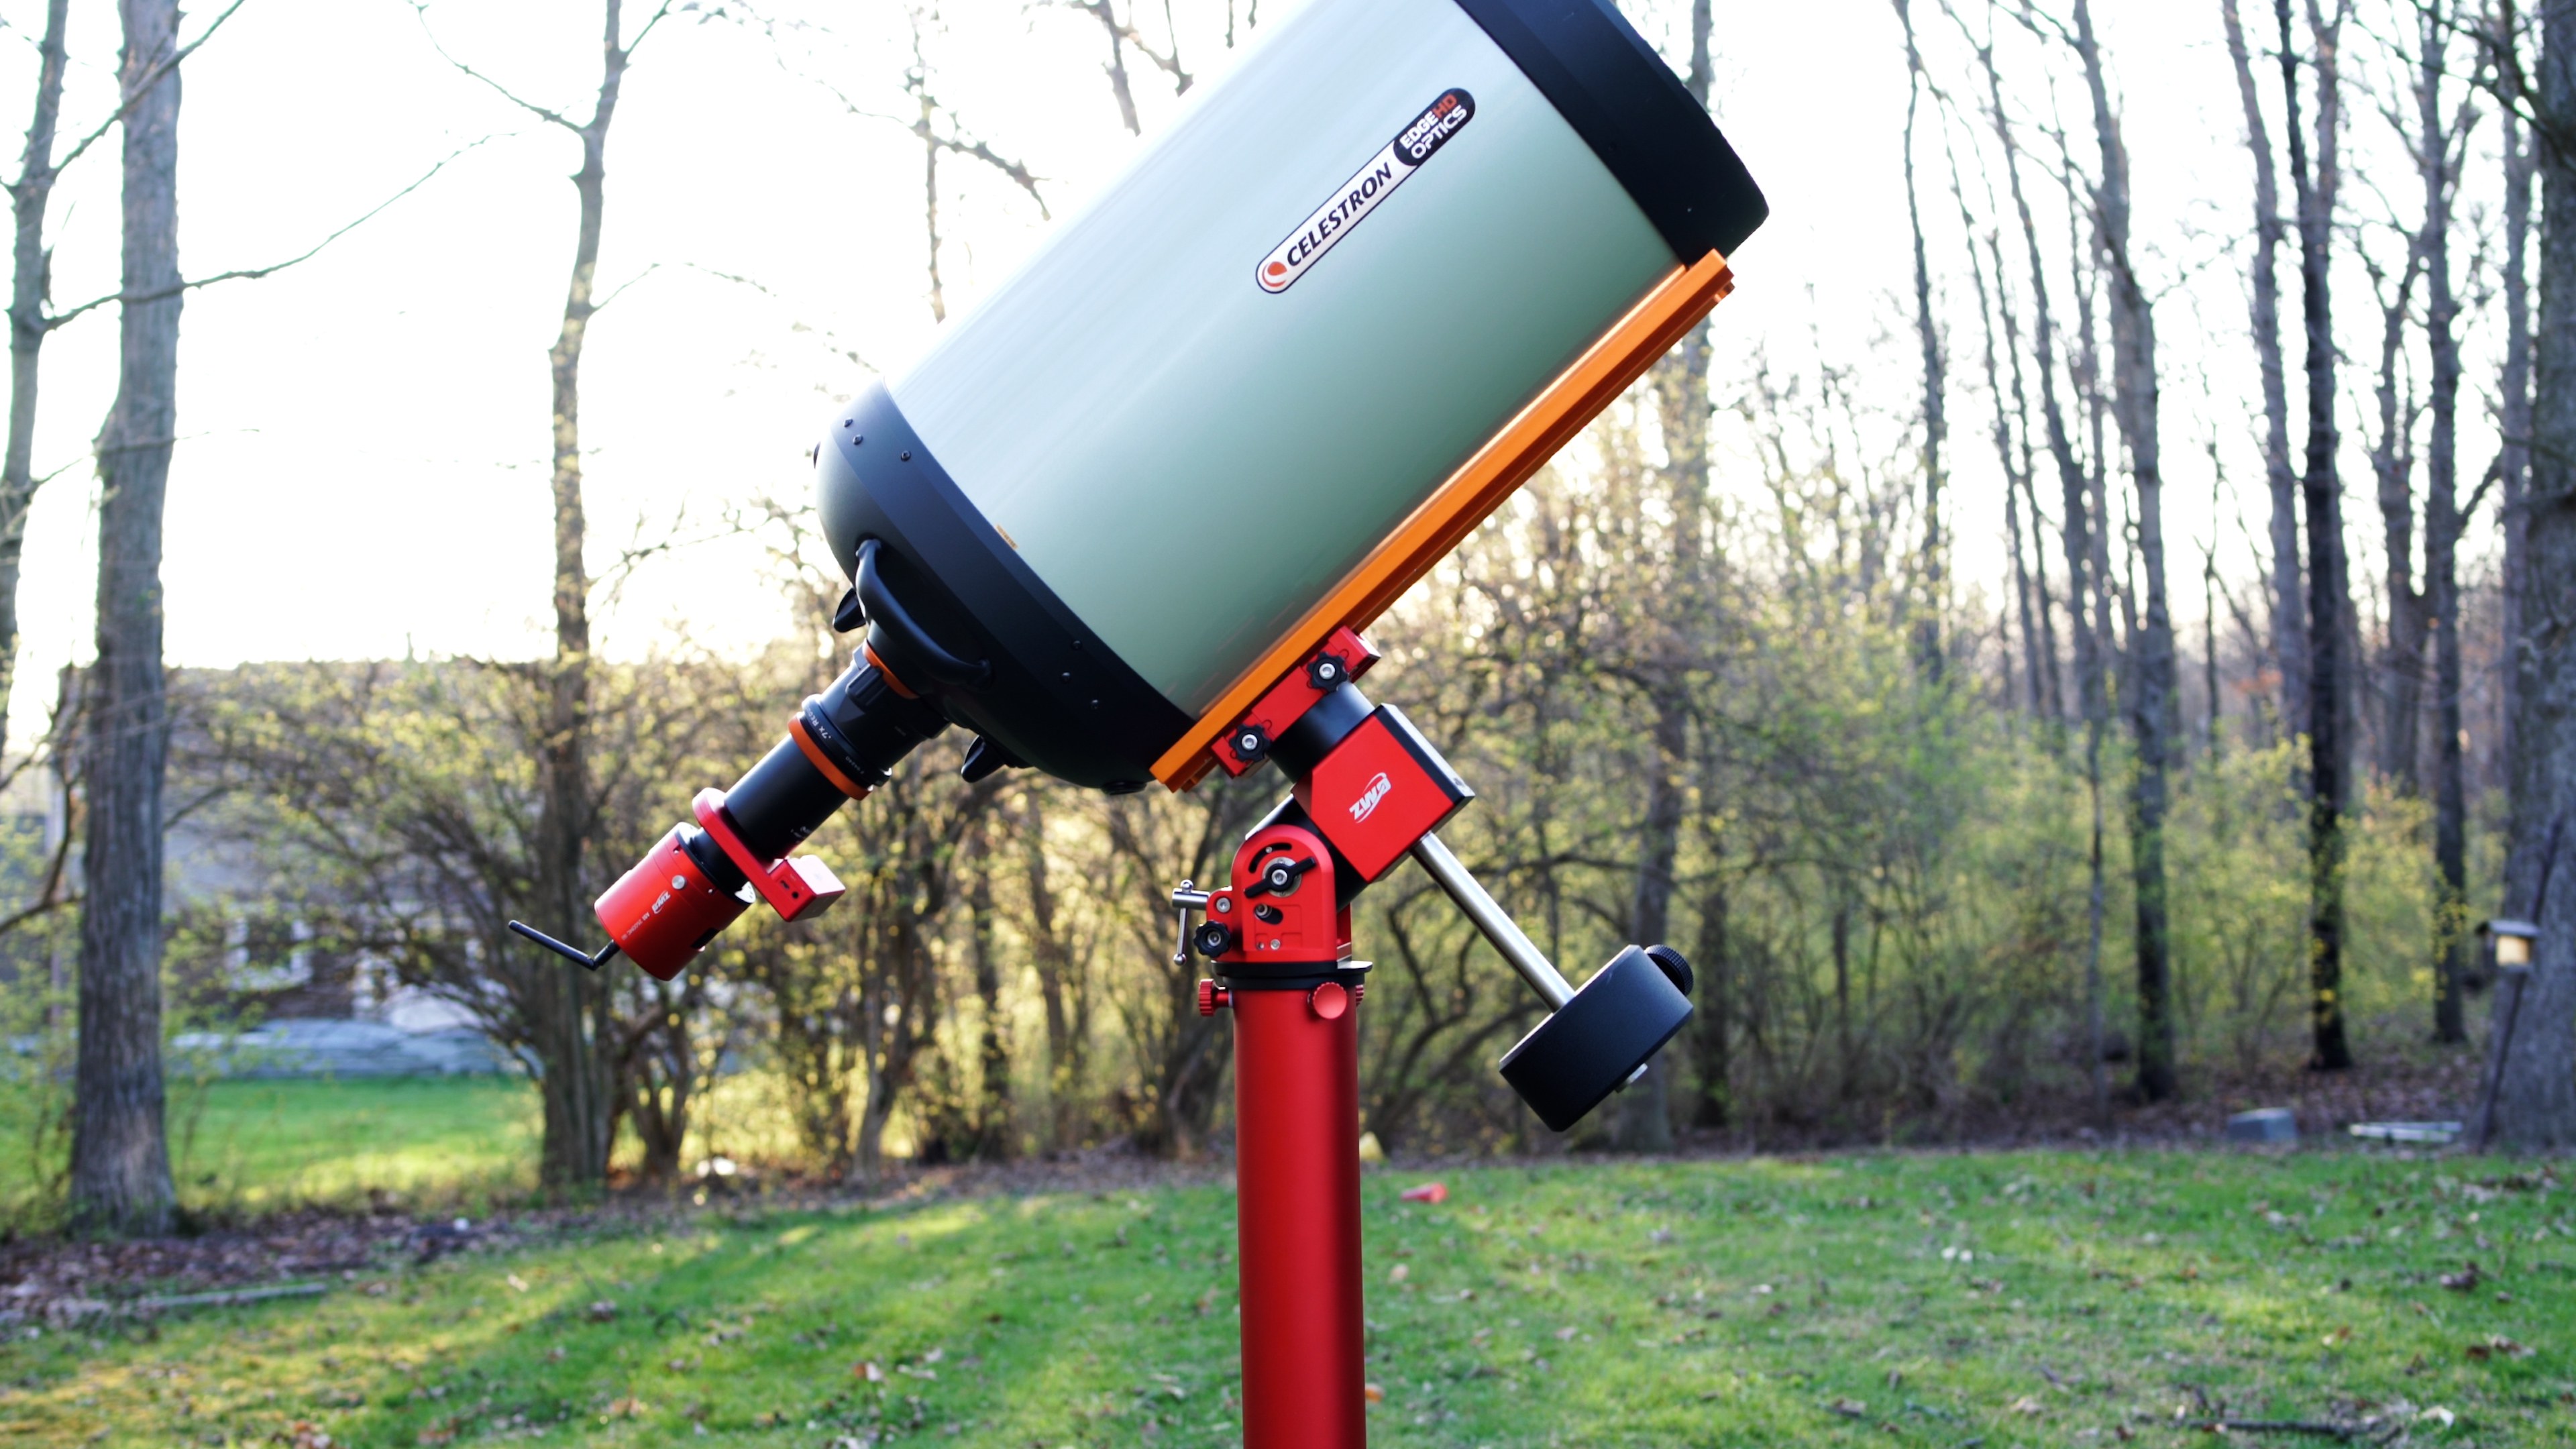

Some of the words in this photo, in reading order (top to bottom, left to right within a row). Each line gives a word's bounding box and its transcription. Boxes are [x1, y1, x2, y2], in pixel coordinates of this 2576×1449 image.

[1410, 105, 1468, 159] OPTICS
[1287, 162, 1392, 267] CELESTRON
[1349, 773, 1392, 824] ZWO
